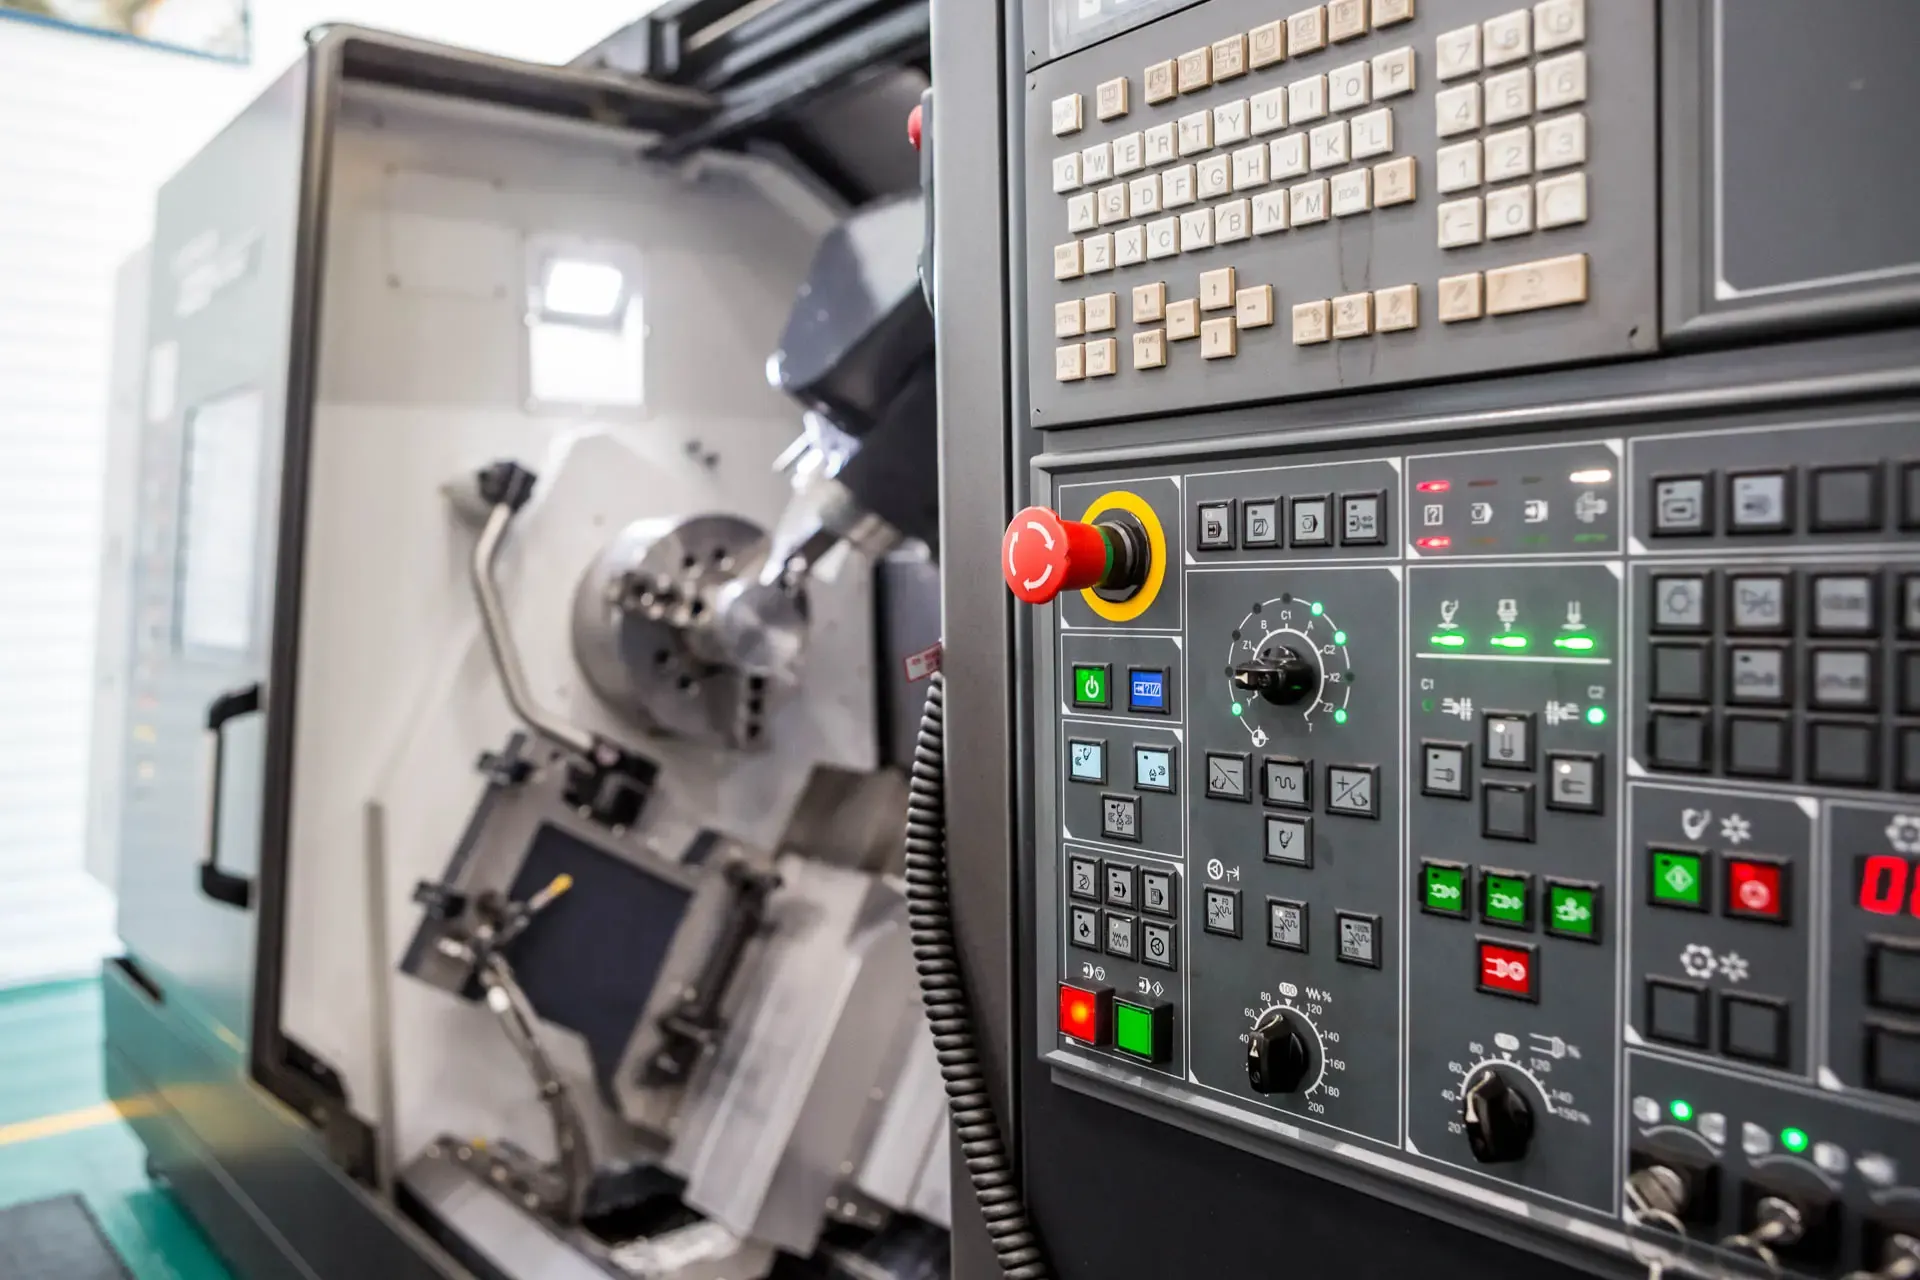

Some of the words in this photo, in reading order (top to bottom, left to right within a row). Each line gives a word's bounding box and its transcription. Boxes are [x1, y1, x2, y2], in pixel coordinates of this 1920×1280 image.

[1457, 42, 1471, 64] 7
[1391, 64, 1404, 83] P
[1266, 102, 1278, 120] U
[1455, 101, 1470, 121] 4
[1229, 113, 1240, 132] Y
[1192, 124, 1203, 142] T
[1369, 126, 1382, 145] L
[1126, 144, 1136, 162] E
[1158, 136, 1169, 153] R
[1326, 136, 1339, 155] K
[1093, 155, 1106, 172] W
[1286, 148, 1298, 167] J
[1505, 147, 1522, 167] 2
[1064, 164, 1076, 182] Q
[1247, 158, 1260, 178] H
[1211, 168, 1224, 186] G
[1175, 177, 1187, 196] F
[1110, 196, 1121, 213] S
[1142, 188, 1154, 205] D
[1305, 194, 1321, 213] M
[1079, 204, 1090, 222] A
[1267, 204, 1280, 222] N
[1230, 213, 1241, 231] B
[1159, 230, 1171, 247] C
[1193, 222, 1206, 240] V
[1096, 246, 1105, 263] Z
[1127, 237, 1138, 256] X
[1280, 610, 1292, 620] C1
[1242, 640, 1251, 650] Z1
[1323, 644, 1336, 655] C2
[1329, 672, 1341, 683] X2
[1420, 678, 1434, 690] C1
[1322, 702, 1334, 713] Z2
[1260, 991, 1271, 1002] 80
[1244, 1008, 1255, 1018] 60
[1306, 1003, 1322, 1015] 120
[1239, 1033, 1249, 1044] 40
[1324, 1030, 1340, 1043] 140
[1469, 1041, 1484, 1056] 80
[1329, 1058, 1345, 1071] 160
[1448, 1061, 1462, 1074] 60
[1530, 1057, 1552, 1073] 120
[1324, 1086, 1340, 1098] 180
[1441, 1089, 1455, 1102] 40
[1307, 1101, 1325, 1114] 200
[1448, 1121, 1461, 1134] 20
